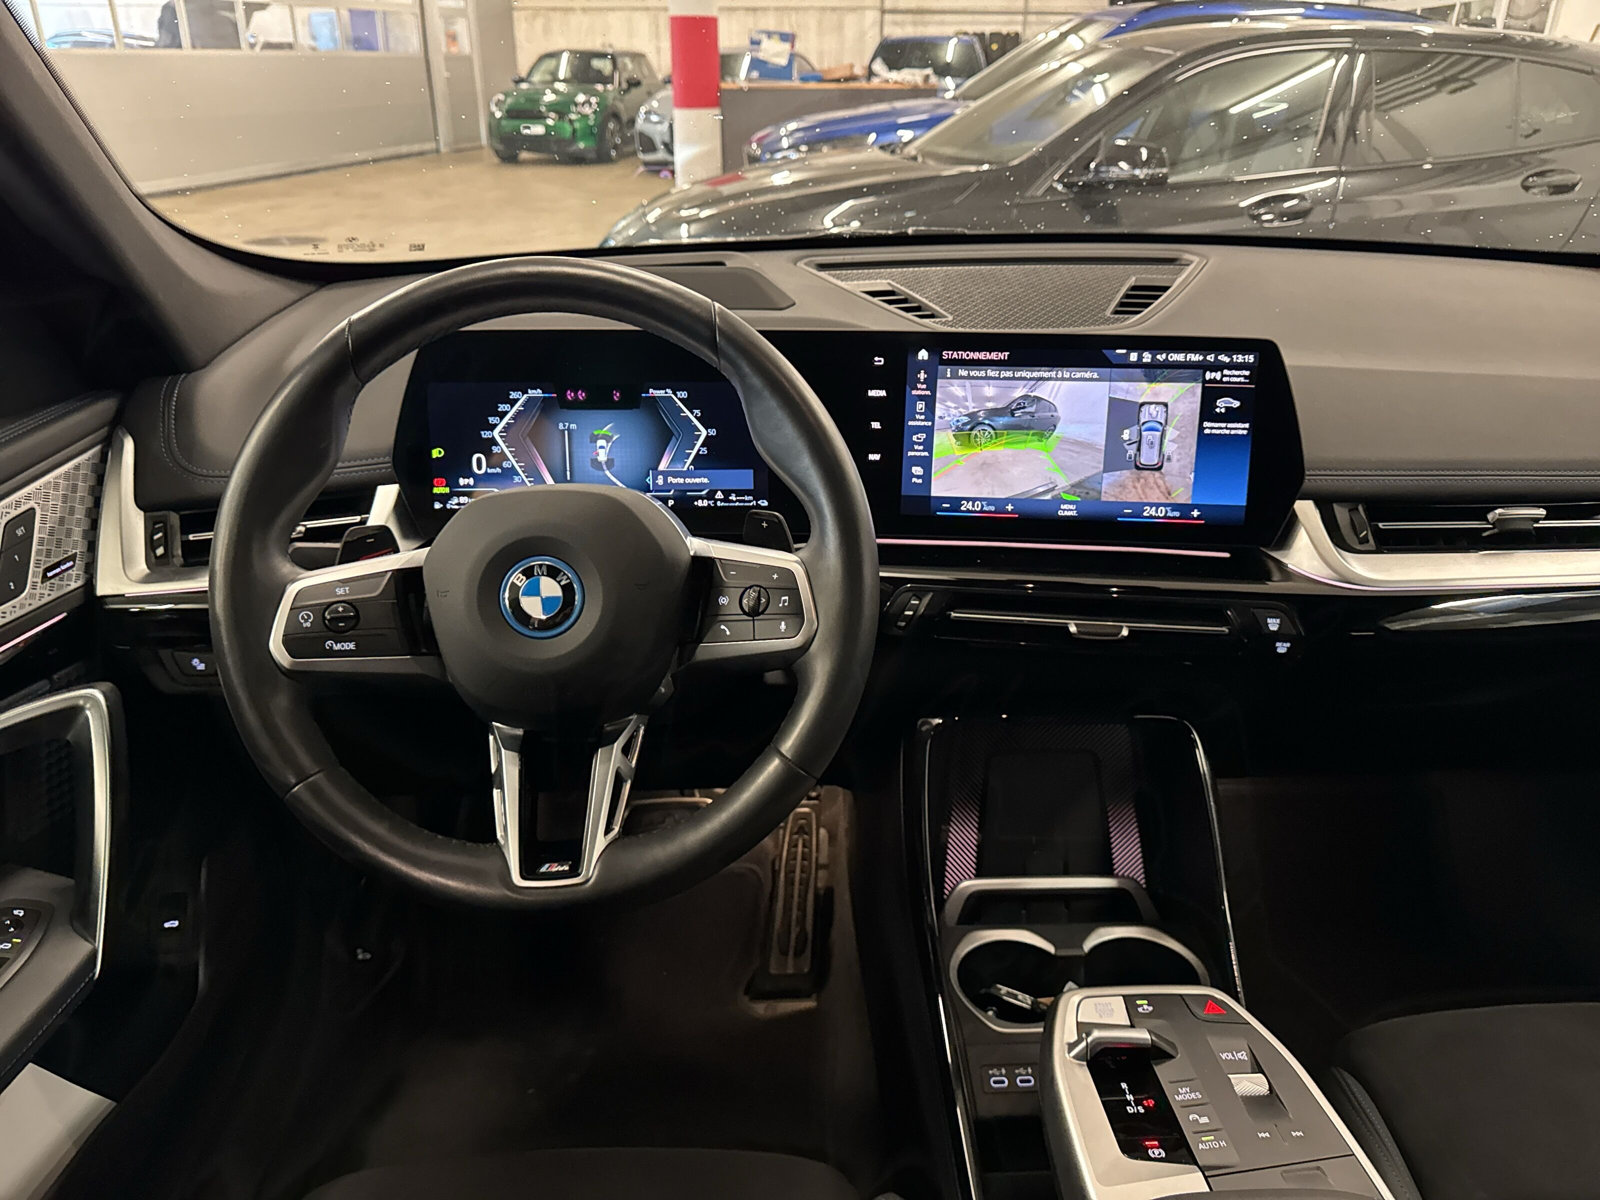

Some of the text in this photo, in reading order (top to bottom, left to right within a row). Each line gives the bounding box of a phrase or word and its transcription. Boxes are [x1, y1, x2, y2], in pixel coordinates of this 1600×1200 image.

[942, 351, 1010, 360] STATIONNEMENT
[1167, 353, 1186, 362] ONE
[1232, 355, 1255, 363] 13:15
[958, 369, 968, 377] Ne
[969, 370, 986, 378] vous
[987, 369, 999, 378] fiez
[1000, 371, 1014, 379] pas
[1014, 371, 1056, 380] uniquement
[1063, 370, 1070, 379] la
[1071, 371, 1100, 379] caméra.
[509, 391, 523, 399] 260
[676, 391, 688, 399] 100
[498, 404, 511, 412] 200
[488, 417, 500, 425] 150
[871, 421, 882, 429] TEL
[480, 430, 493, 438] 120
[492, 446, 501, 454] 90
[699, 447, 708, 455] 25
[868, 453, 881, 461] NAV
[472, 453, 486, 474] 0
[513, 475, 522, 483] 30
[960, 501, 981, 511] 24.0
[1142, 506, 1165, 517] 24.0
[513, 564, 571, 587] BMW
[335, 586, 350, 595] SET
[332, 641, 357, 651] MODE
[1219, 1052, 1235, 1060] VOL
[1120, 1082, 1129, 1091] R
[1174, 1092, 1202, 1101] MODES
[1198, 1140, 1227, 1150] AUTO H
